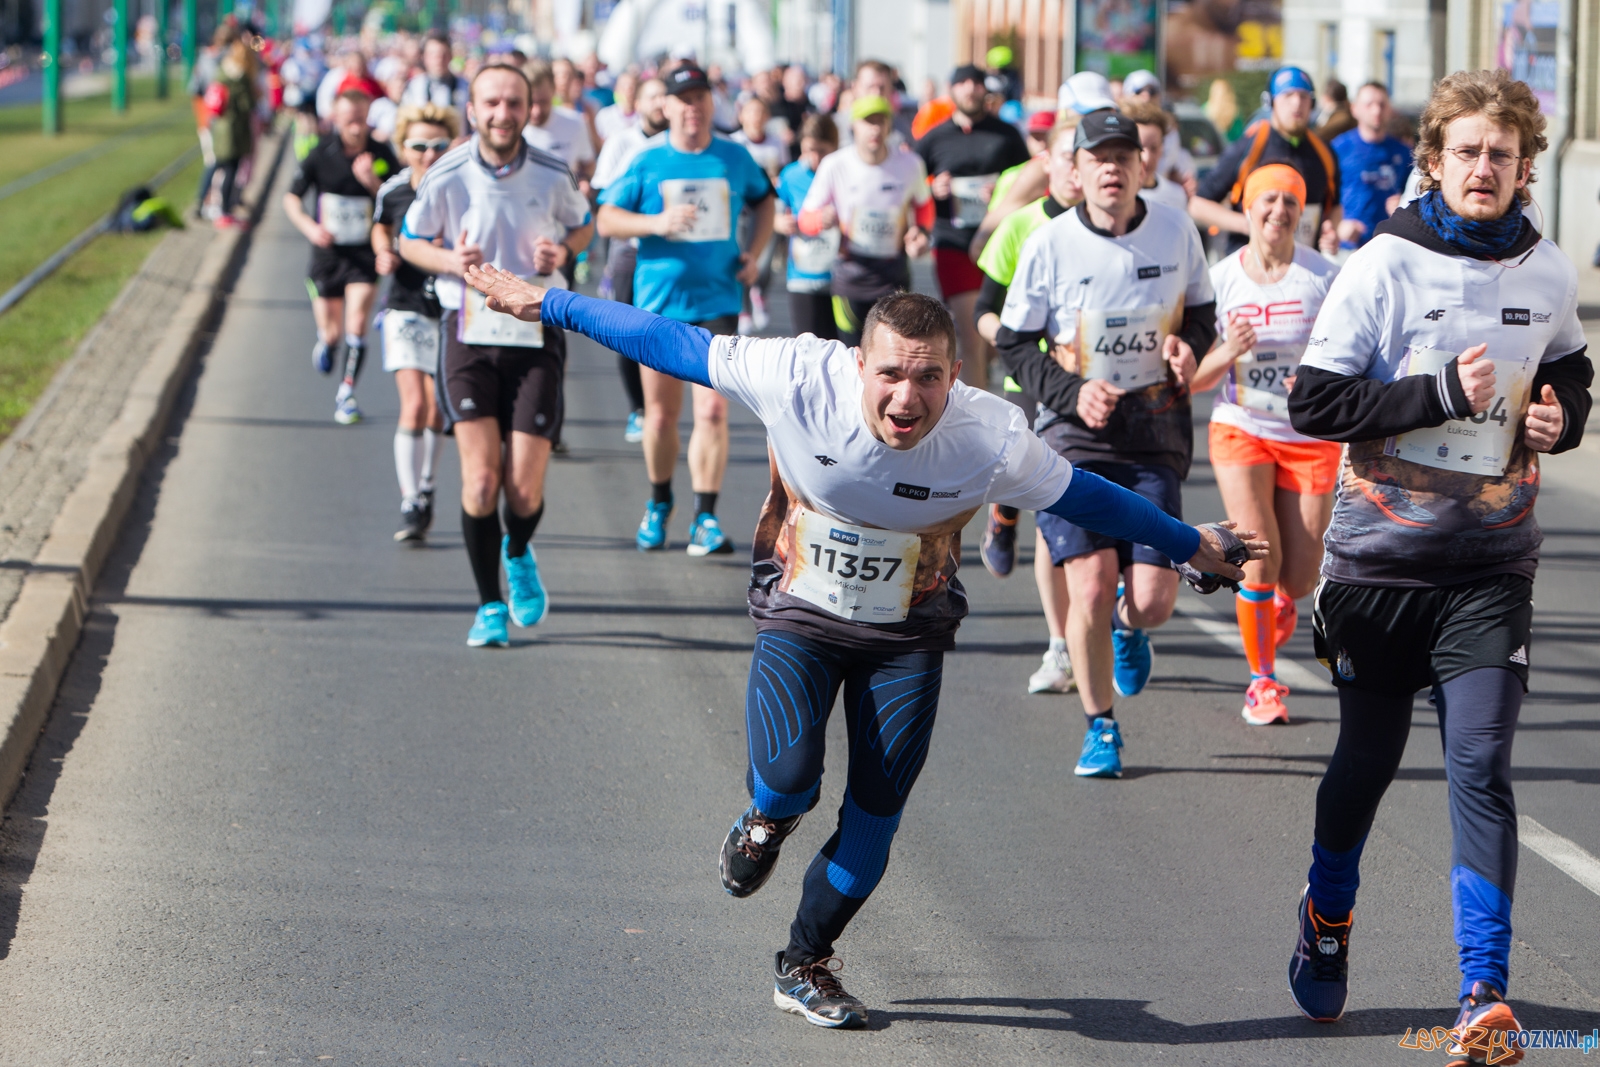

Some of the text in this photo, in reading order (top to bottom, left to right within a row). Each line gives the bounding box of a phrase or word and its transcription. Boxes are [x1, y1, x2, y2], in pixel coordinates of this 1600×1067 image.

[1424, 309, 1446, 321] 4F
[1515, 313, 1528, 321] PKO
[1094, 330, 1158, 356] 4643
[1447, 425, 1478, 437] Łukasz
[814, 455, 838, 467] 4F
[908, 488, 927, 498] PKO
[832, 531, 857, 543] 10. PKO
[809, 543, 903, 582] 11357
[835, 579, 868, 593] Mikołaj
